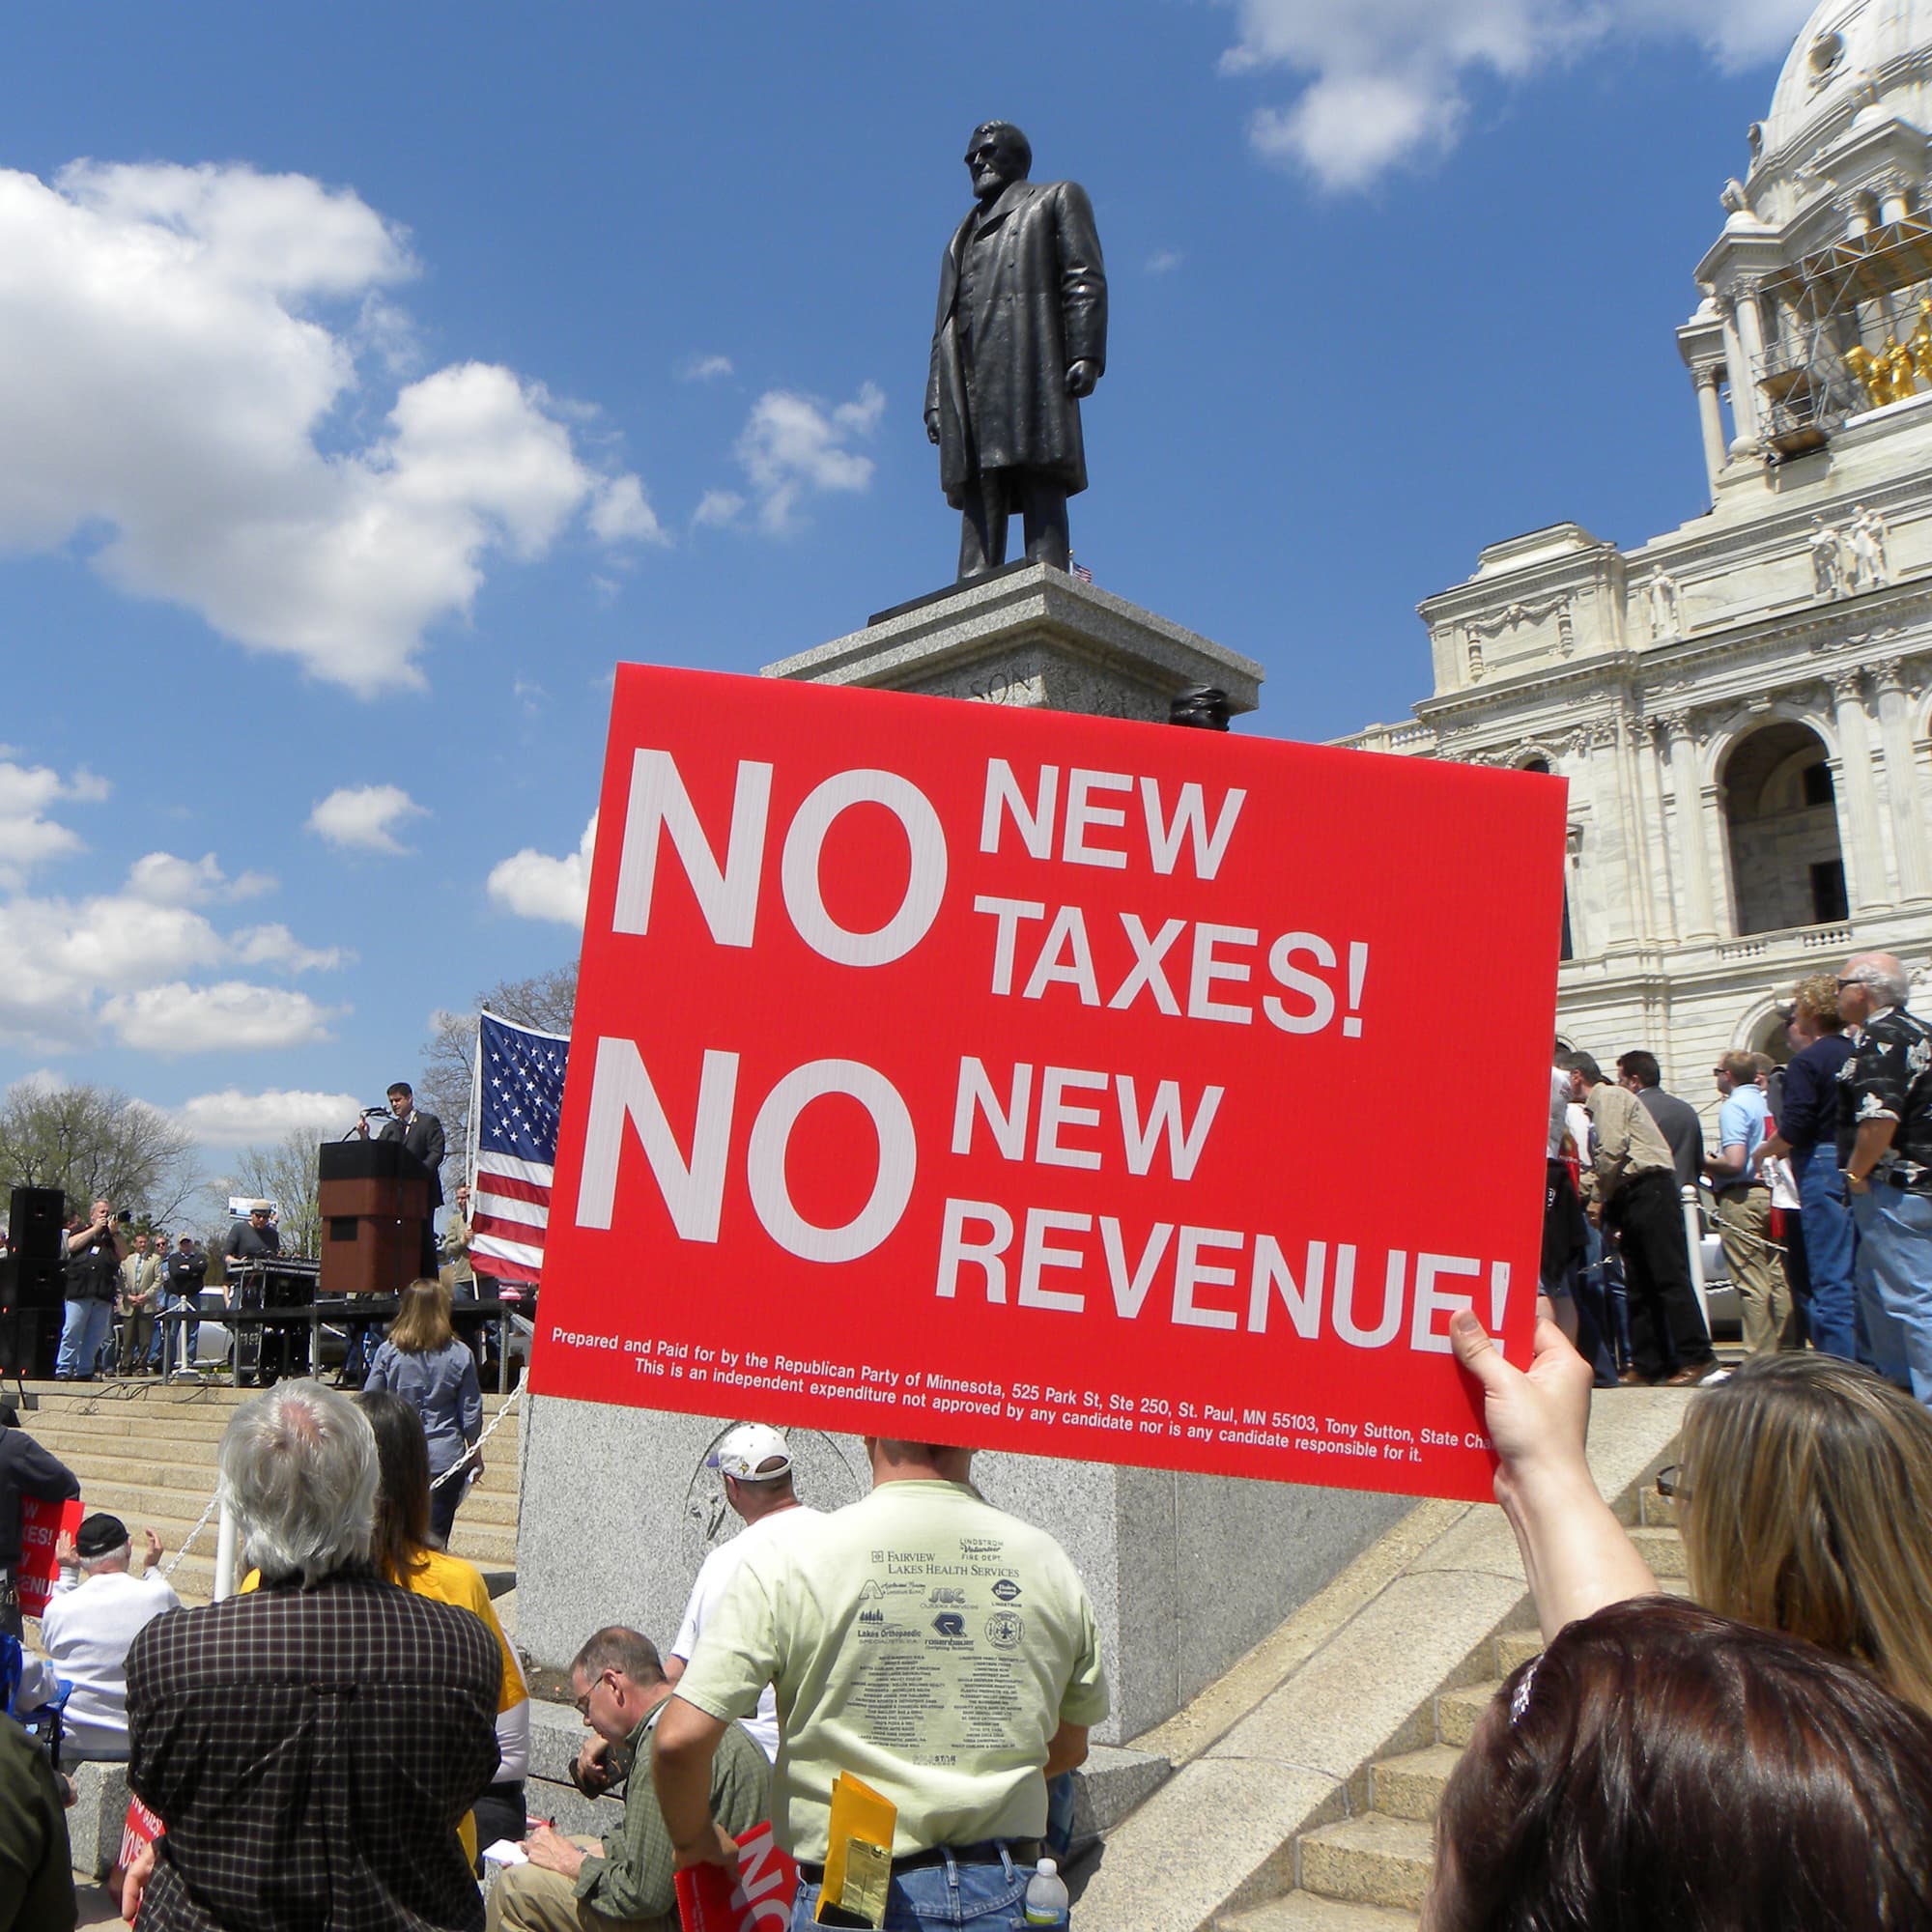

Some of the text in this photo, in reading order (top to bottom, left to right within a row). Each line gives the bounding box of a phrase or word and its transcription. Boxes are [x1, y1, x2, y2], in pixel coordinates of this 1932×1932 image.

[612, 748, 948, 967] NO
[980, 758, 1246, 880] NEW
[974, 895, 1368, 1037] TAXES!
[576, 1036, 917, 1263] NO
[952, 1056, 1224, 1180] NEW
[936, 1198, 1511, 1355] REVENUE!
[552, 1326, 1491, 1450] Prepared and Paid for by the Republican Party of Minnesota, 525 Park St, Ste 250, St. Paul, MN 55103, Tony Sutton, State Cha
[635, 1356, 1423, 1463] This is an independent expenditure not approved by any candidate nor is any candidate responsible for it.
[887, 1550, 936, 1562] FAIRVIEW
[888, 1564, 1020, 1578] LAKES HEALTH SERVICES
[858, 1630, 879, 1638] Lakes
[924, 1637, 975, 1646] rosenbauer
